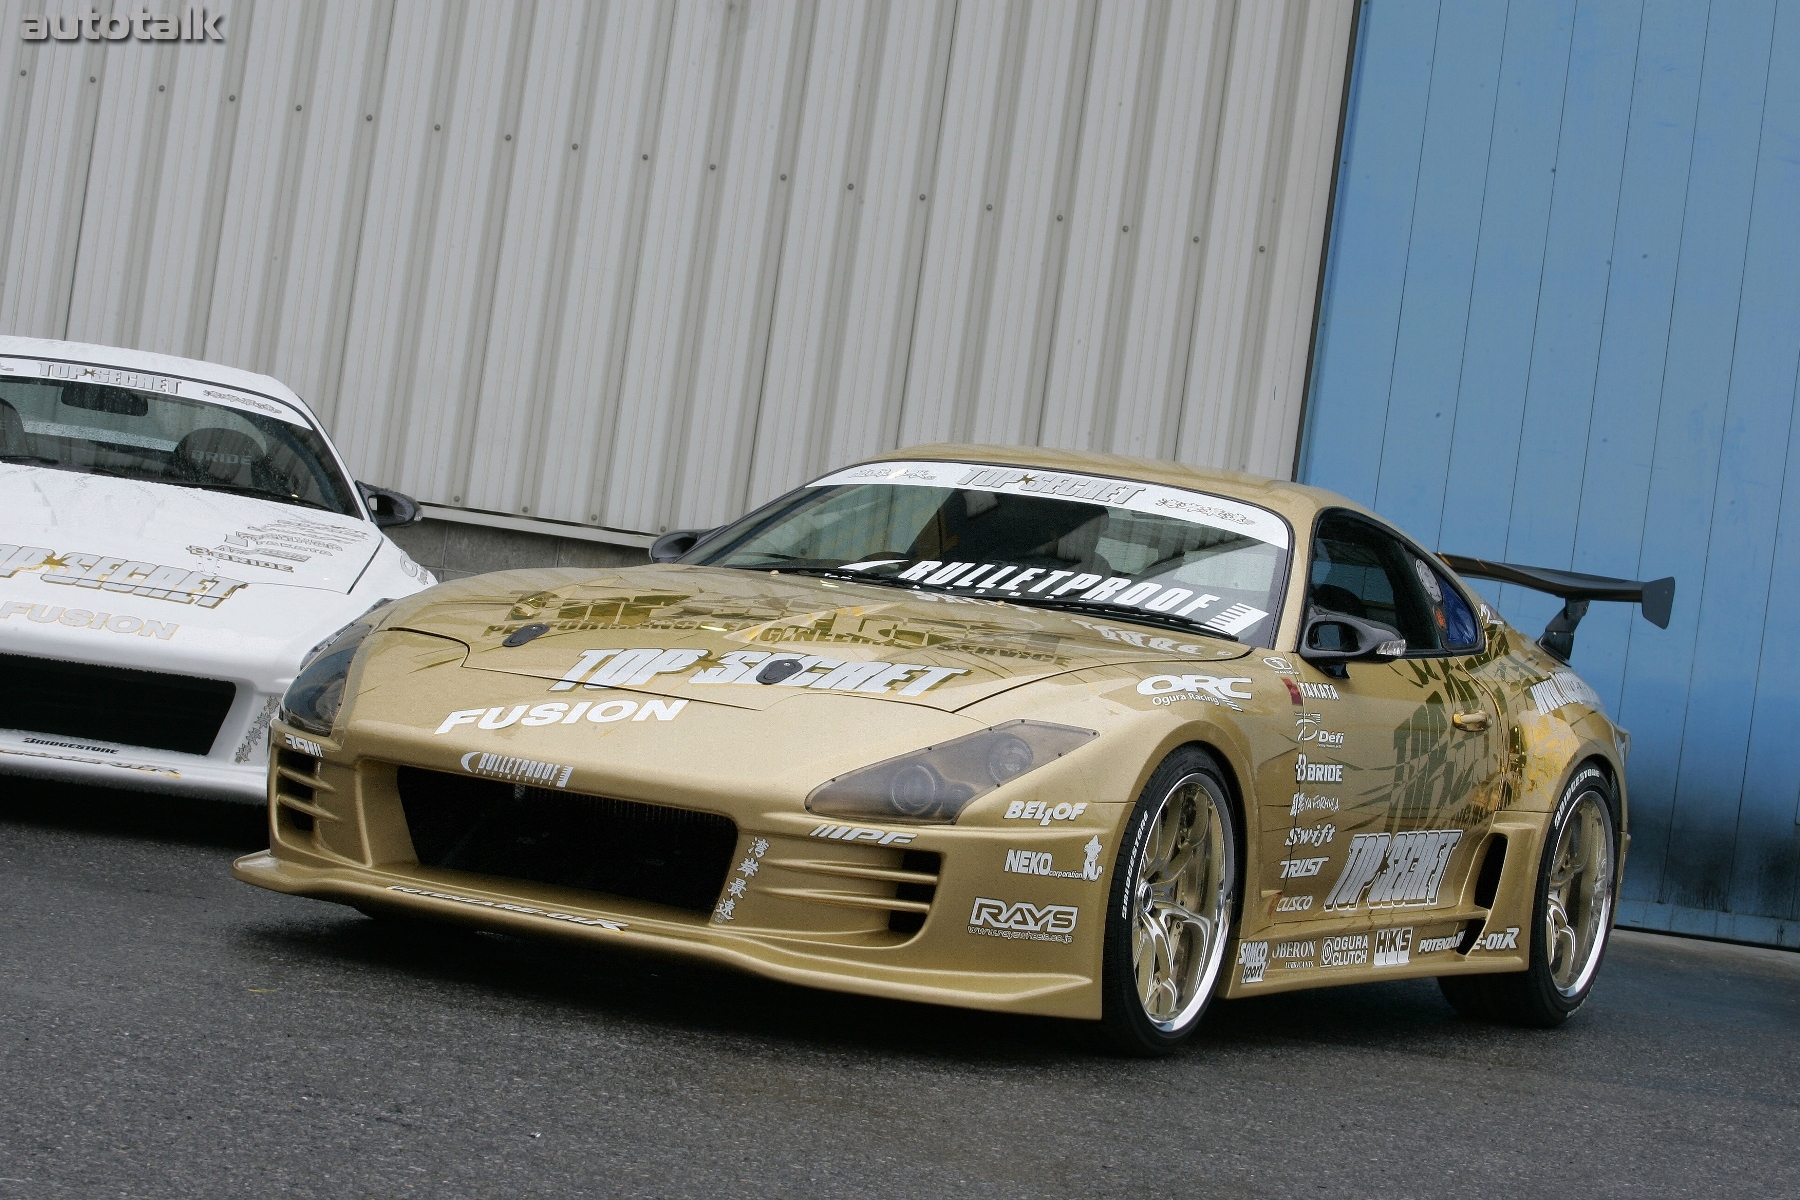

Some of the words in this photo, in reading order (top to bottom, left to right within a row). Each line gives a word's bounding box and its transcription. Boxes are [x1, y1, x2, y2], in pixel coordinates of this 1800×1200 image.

[40, 362, 87, 380] TOP
[91, 367, 182, 394] SECRET
[957, 467, 1023, 489] TOP
[1019, 473, 1147, 505] SECRET
[40, 552, 250, 609] SECRET
[0, 601, 180, 641] FUSION
[548, 648, 708, 692] TOP
[1136, 674, 1253, 712] ORC
[1152, 691, 1187, 706] Ogura
[1188, 692, 1220, 706] Racing
[1299, 682, 1340, 700] TAKATA
[434, 699, 690, 735] FUSION
[477, 752, 561, 781] BULLETPROOF
[1284, 823, 1337, 847] Swift
[1004, 849, 1053, 875] NEKO
[1049, 869, 1083, 879] corporation
[1279, 856, 1331, 879] TRUST
[968, 897, 1079, 934] RAYS
[1332, 949, 1368, 966] CLUTCH
[1333, 934, 1369, 951] OGURA
[1374, 927, 1413, 962] HKS
